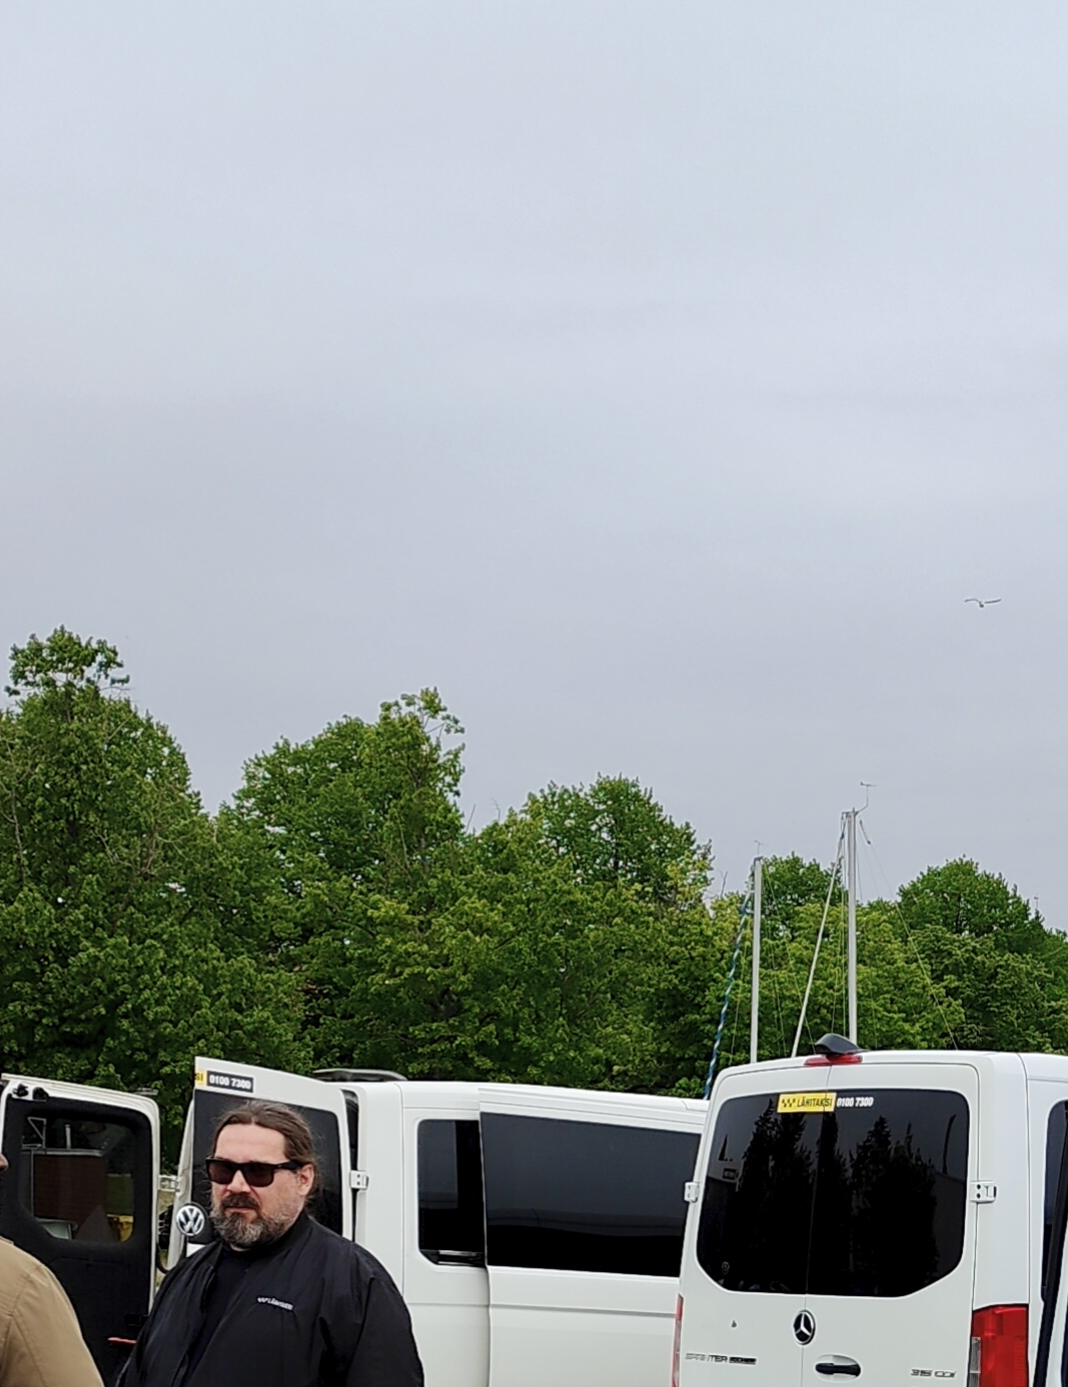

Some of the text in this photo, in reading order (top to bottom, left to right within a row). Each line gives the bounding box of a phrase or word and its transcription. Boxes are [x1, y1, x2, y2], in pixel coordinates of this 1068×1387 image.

[209, 1074, 230, 1087] 0100
[837, 1097, 854, 1108] 0100
[855, 1096, 874, 1107] 7300
